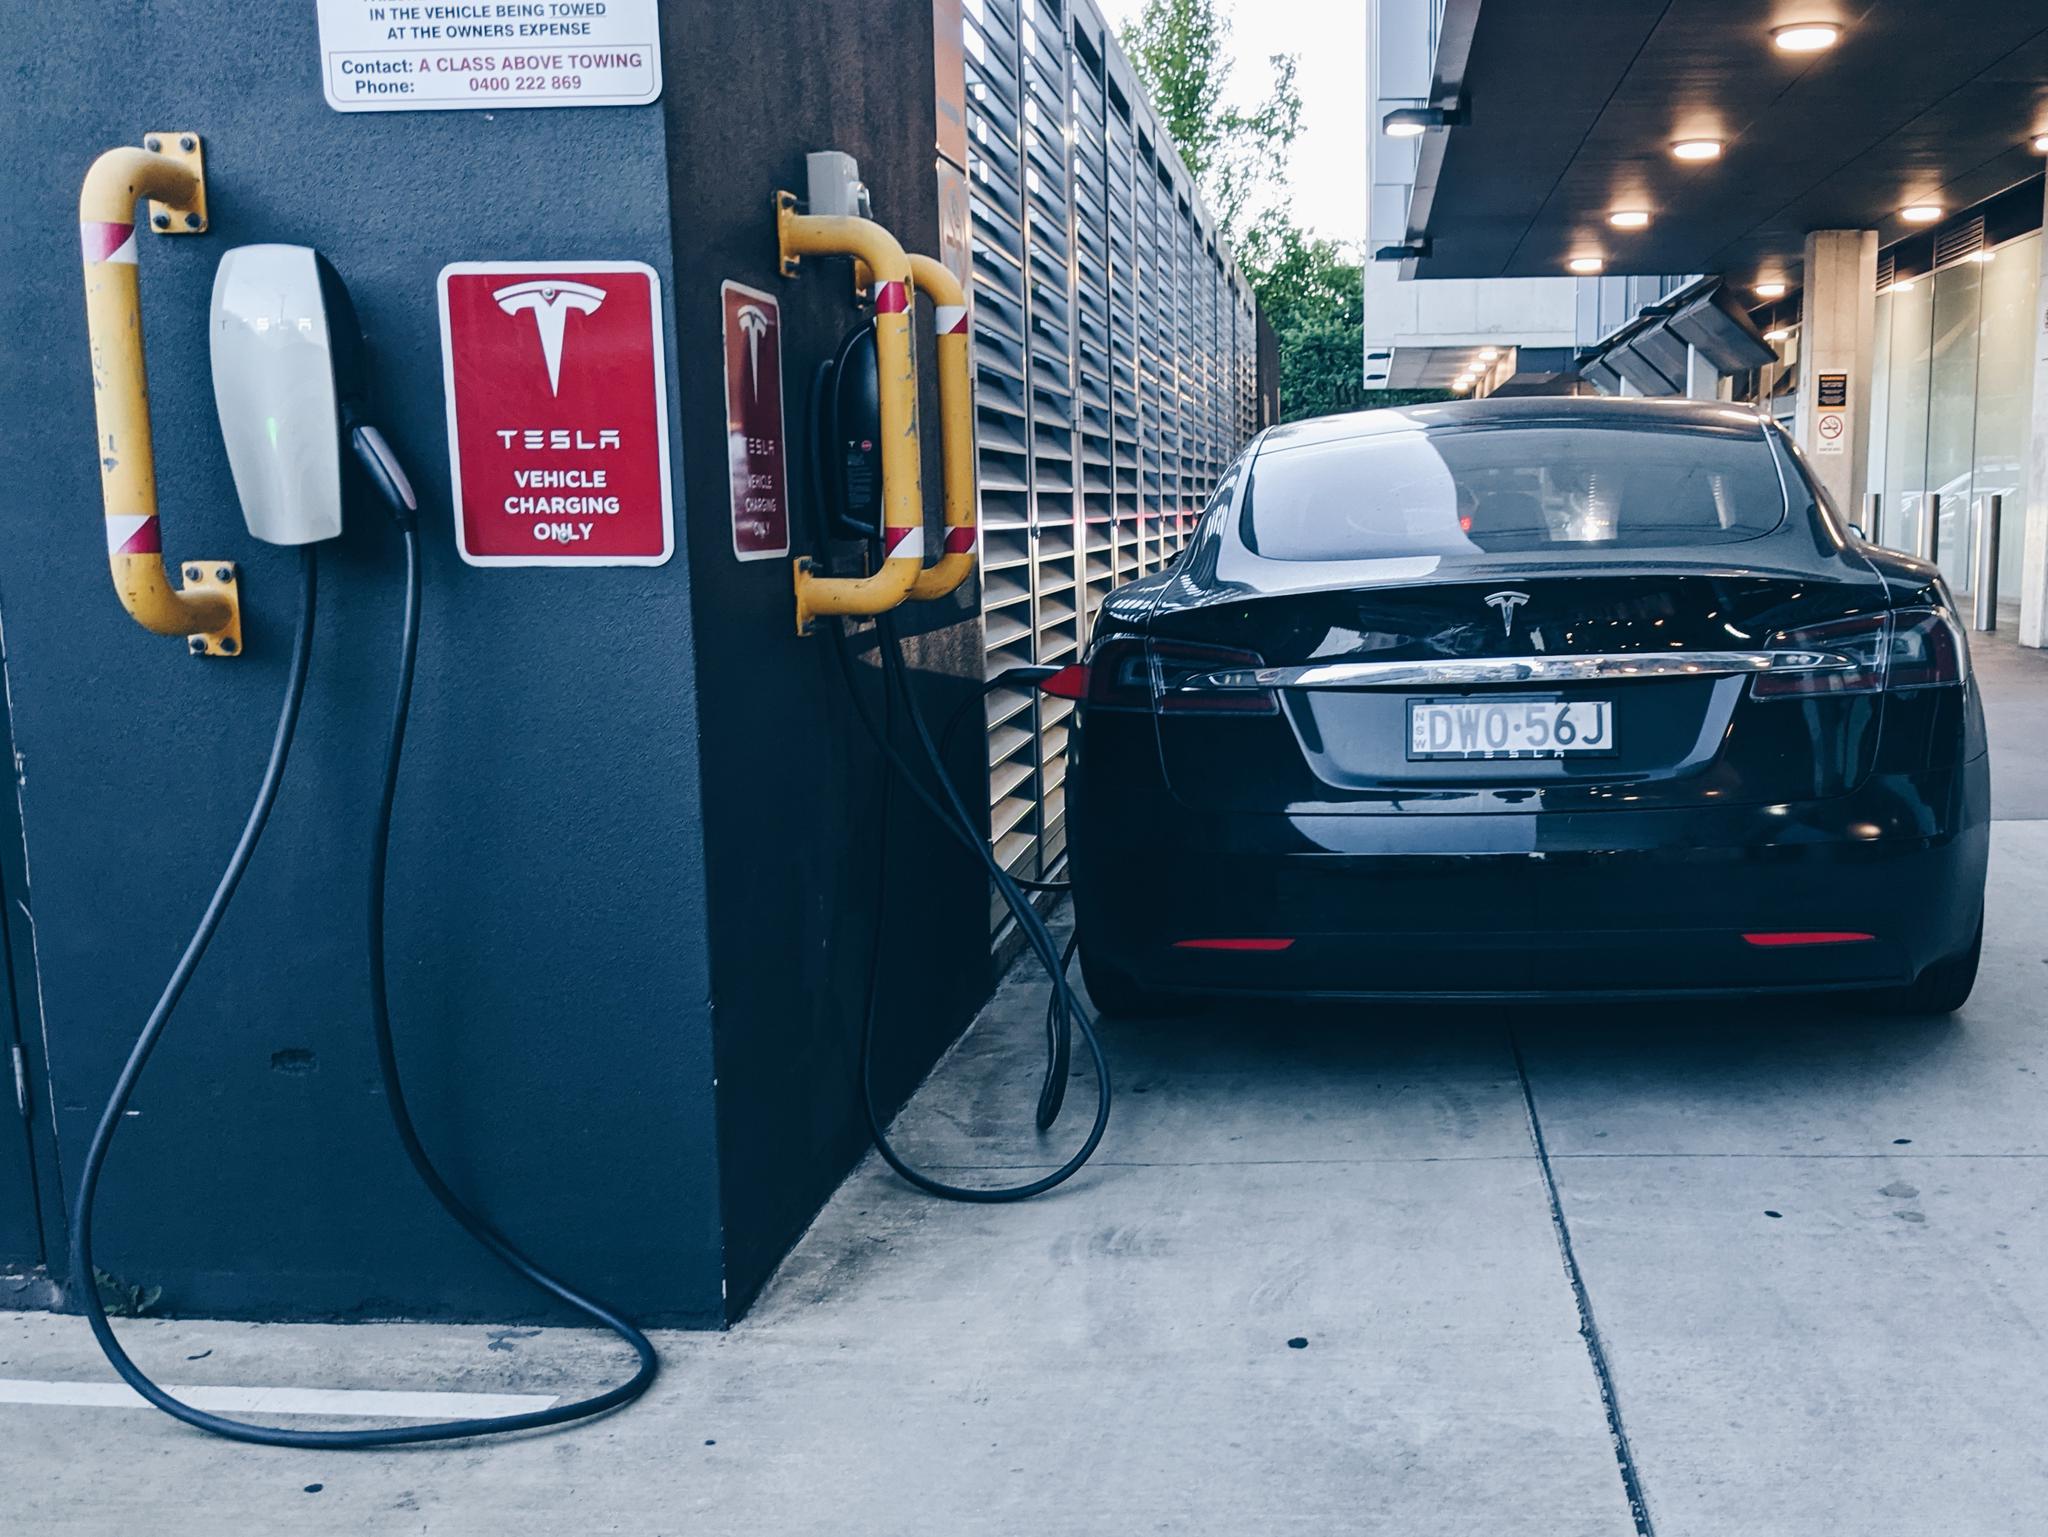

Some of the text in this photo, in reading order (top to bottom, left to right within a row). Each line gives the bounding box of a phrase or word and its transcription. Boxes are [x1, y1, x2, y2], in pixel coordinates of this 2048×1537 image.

[369, 3, 606, 21] IN THE VEHICLE BEING TOWED
[387, 22, 591, 40] AT THE OWNERS EXPENSE
[341, 53, 642, 74] Contact: A CLASS ABOVE TOWING
[355, 75, 582, 94] Phone: 0400 222 869
[496, 430, 620, 450] TESLA
[514, 470, 607, 488] VEHICLE
[504, 496, 620, 515] CHARGING
[533, 522, 594, 541] ONLY
